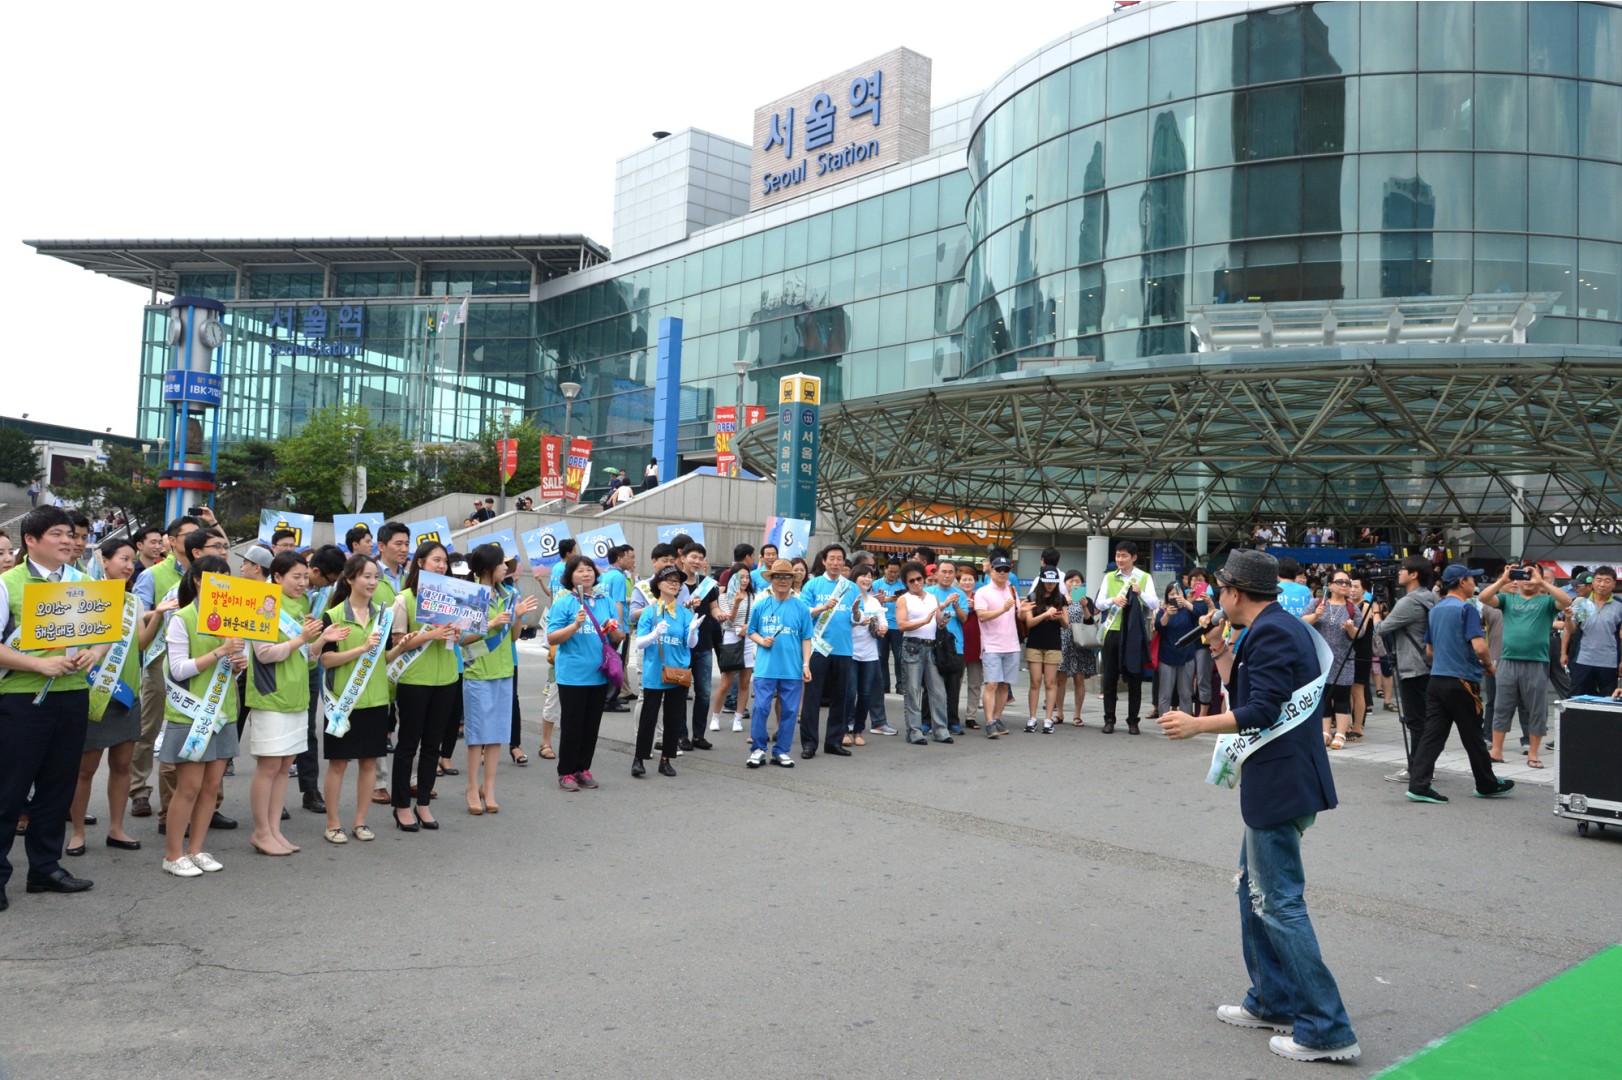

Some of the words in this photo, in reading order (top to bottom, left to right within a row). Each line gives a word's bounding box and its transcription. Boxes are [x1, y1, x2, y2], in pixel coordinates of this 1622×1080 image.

[762, 158, 807, 196] Seoul
[816, 139, 879, 176] Station
[269, 341, 307, 356] Seoul
[312, 341, 361, 356] Station
[717, 422, 735, 432] OPEN
[716, 433, 735, 452] SAL
[567, 455, 588, 468] OPEN
[542, 477, 563, 489] SALE
[211, 591, 242, 607] 망설이지
[35, 622, 75, 640] 해운대로
[223, 616, 256, 631] 해운대로
